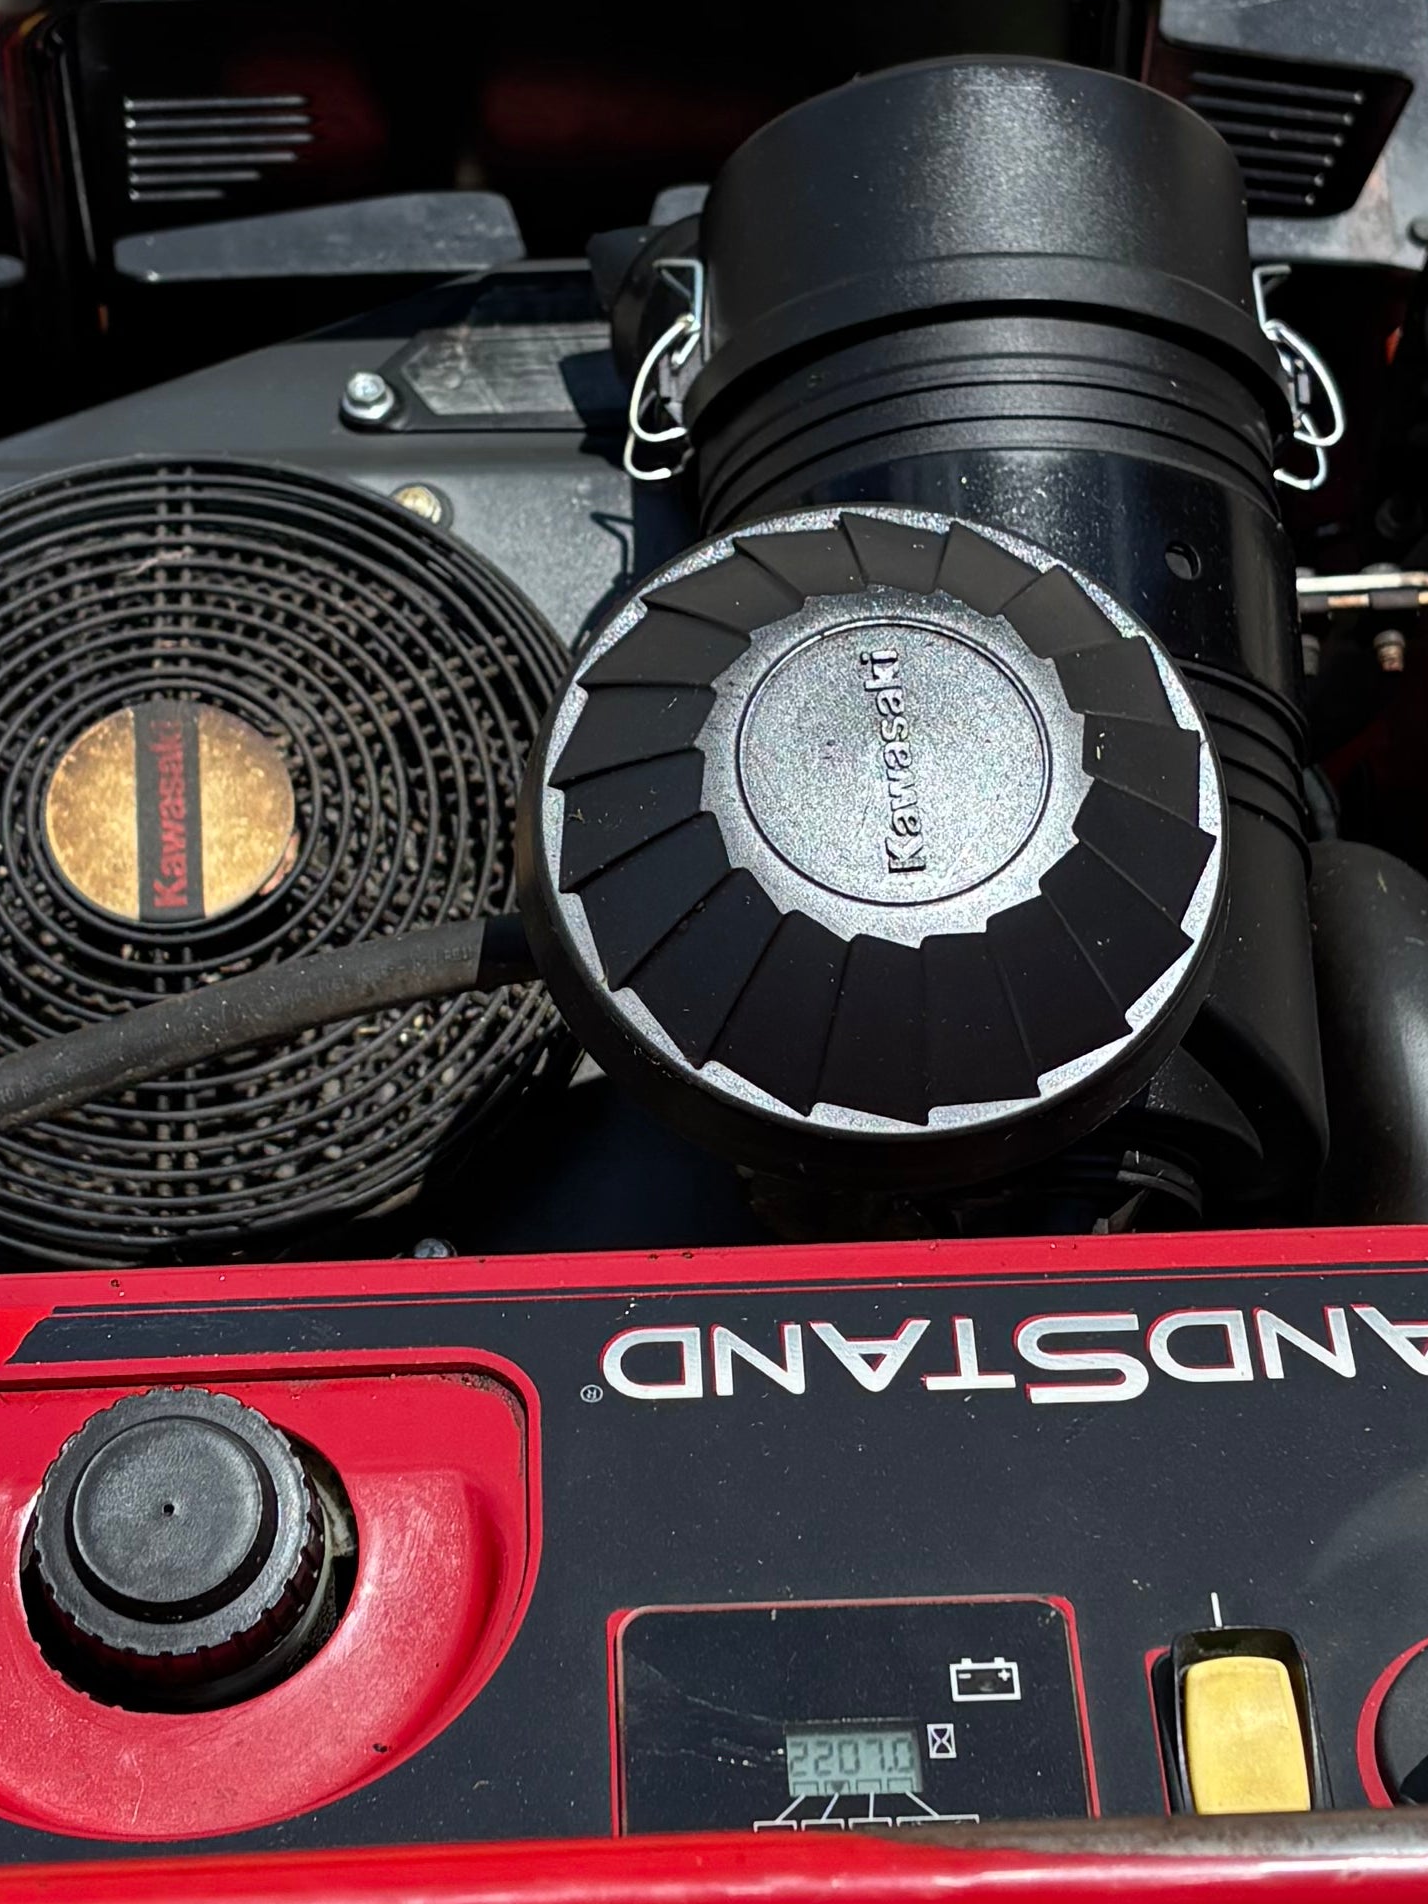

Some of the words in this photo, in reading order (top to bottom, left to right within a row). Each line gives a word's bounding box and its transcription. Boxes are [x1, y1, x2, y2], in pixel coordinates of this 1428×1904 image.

[149, 719, 189, 909] Kawasaki
[858, 646, 927, 875] Kawasaki
[789, 1736, 917, 1777] 2207.0
